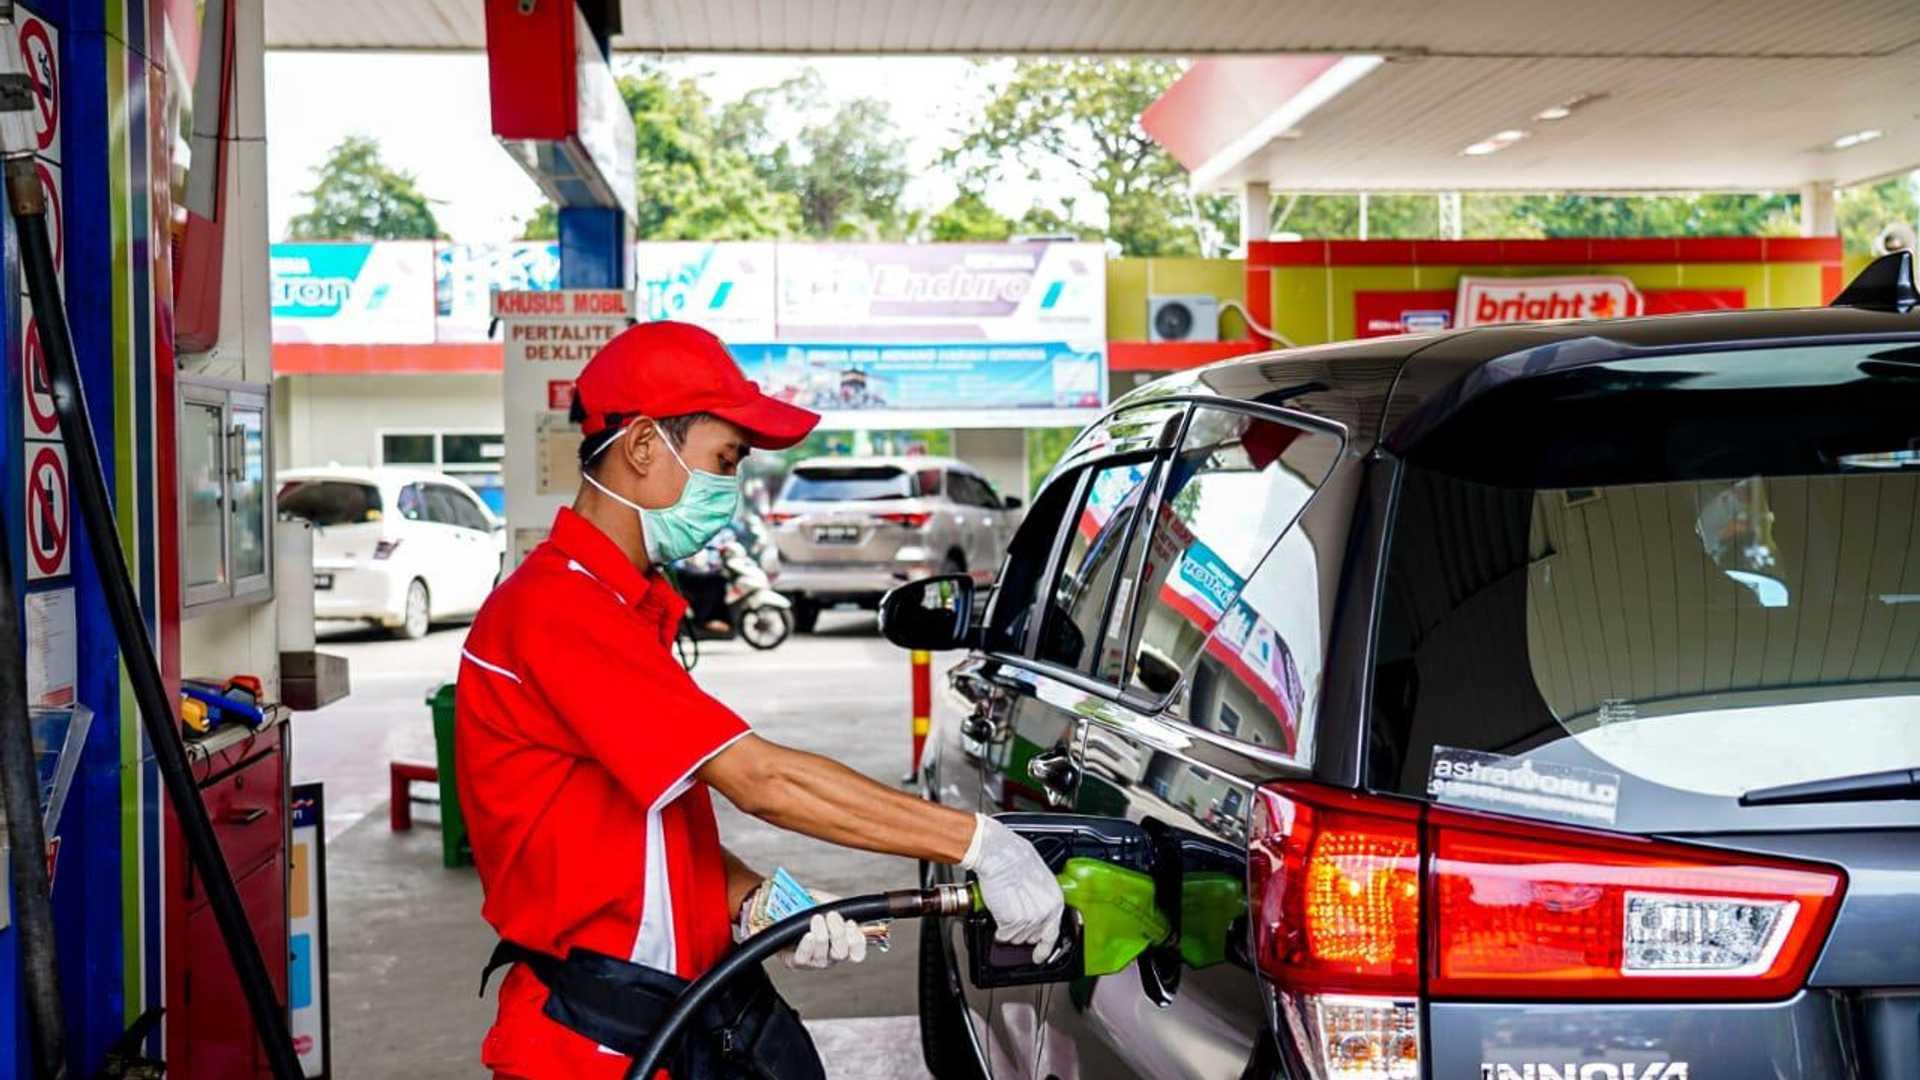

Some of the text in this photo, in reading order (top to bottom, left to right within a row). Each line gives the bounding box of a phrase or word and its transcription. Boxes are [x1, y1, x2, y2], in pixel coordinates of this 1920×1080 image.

[497, 292, 627, 314] KHUSUS MOBIL
[1477, 291, 1583, 322] bright
[512, 325, 615, 342] PERTALITE
[1481, 1061, 1689, 1080] INNOVA
